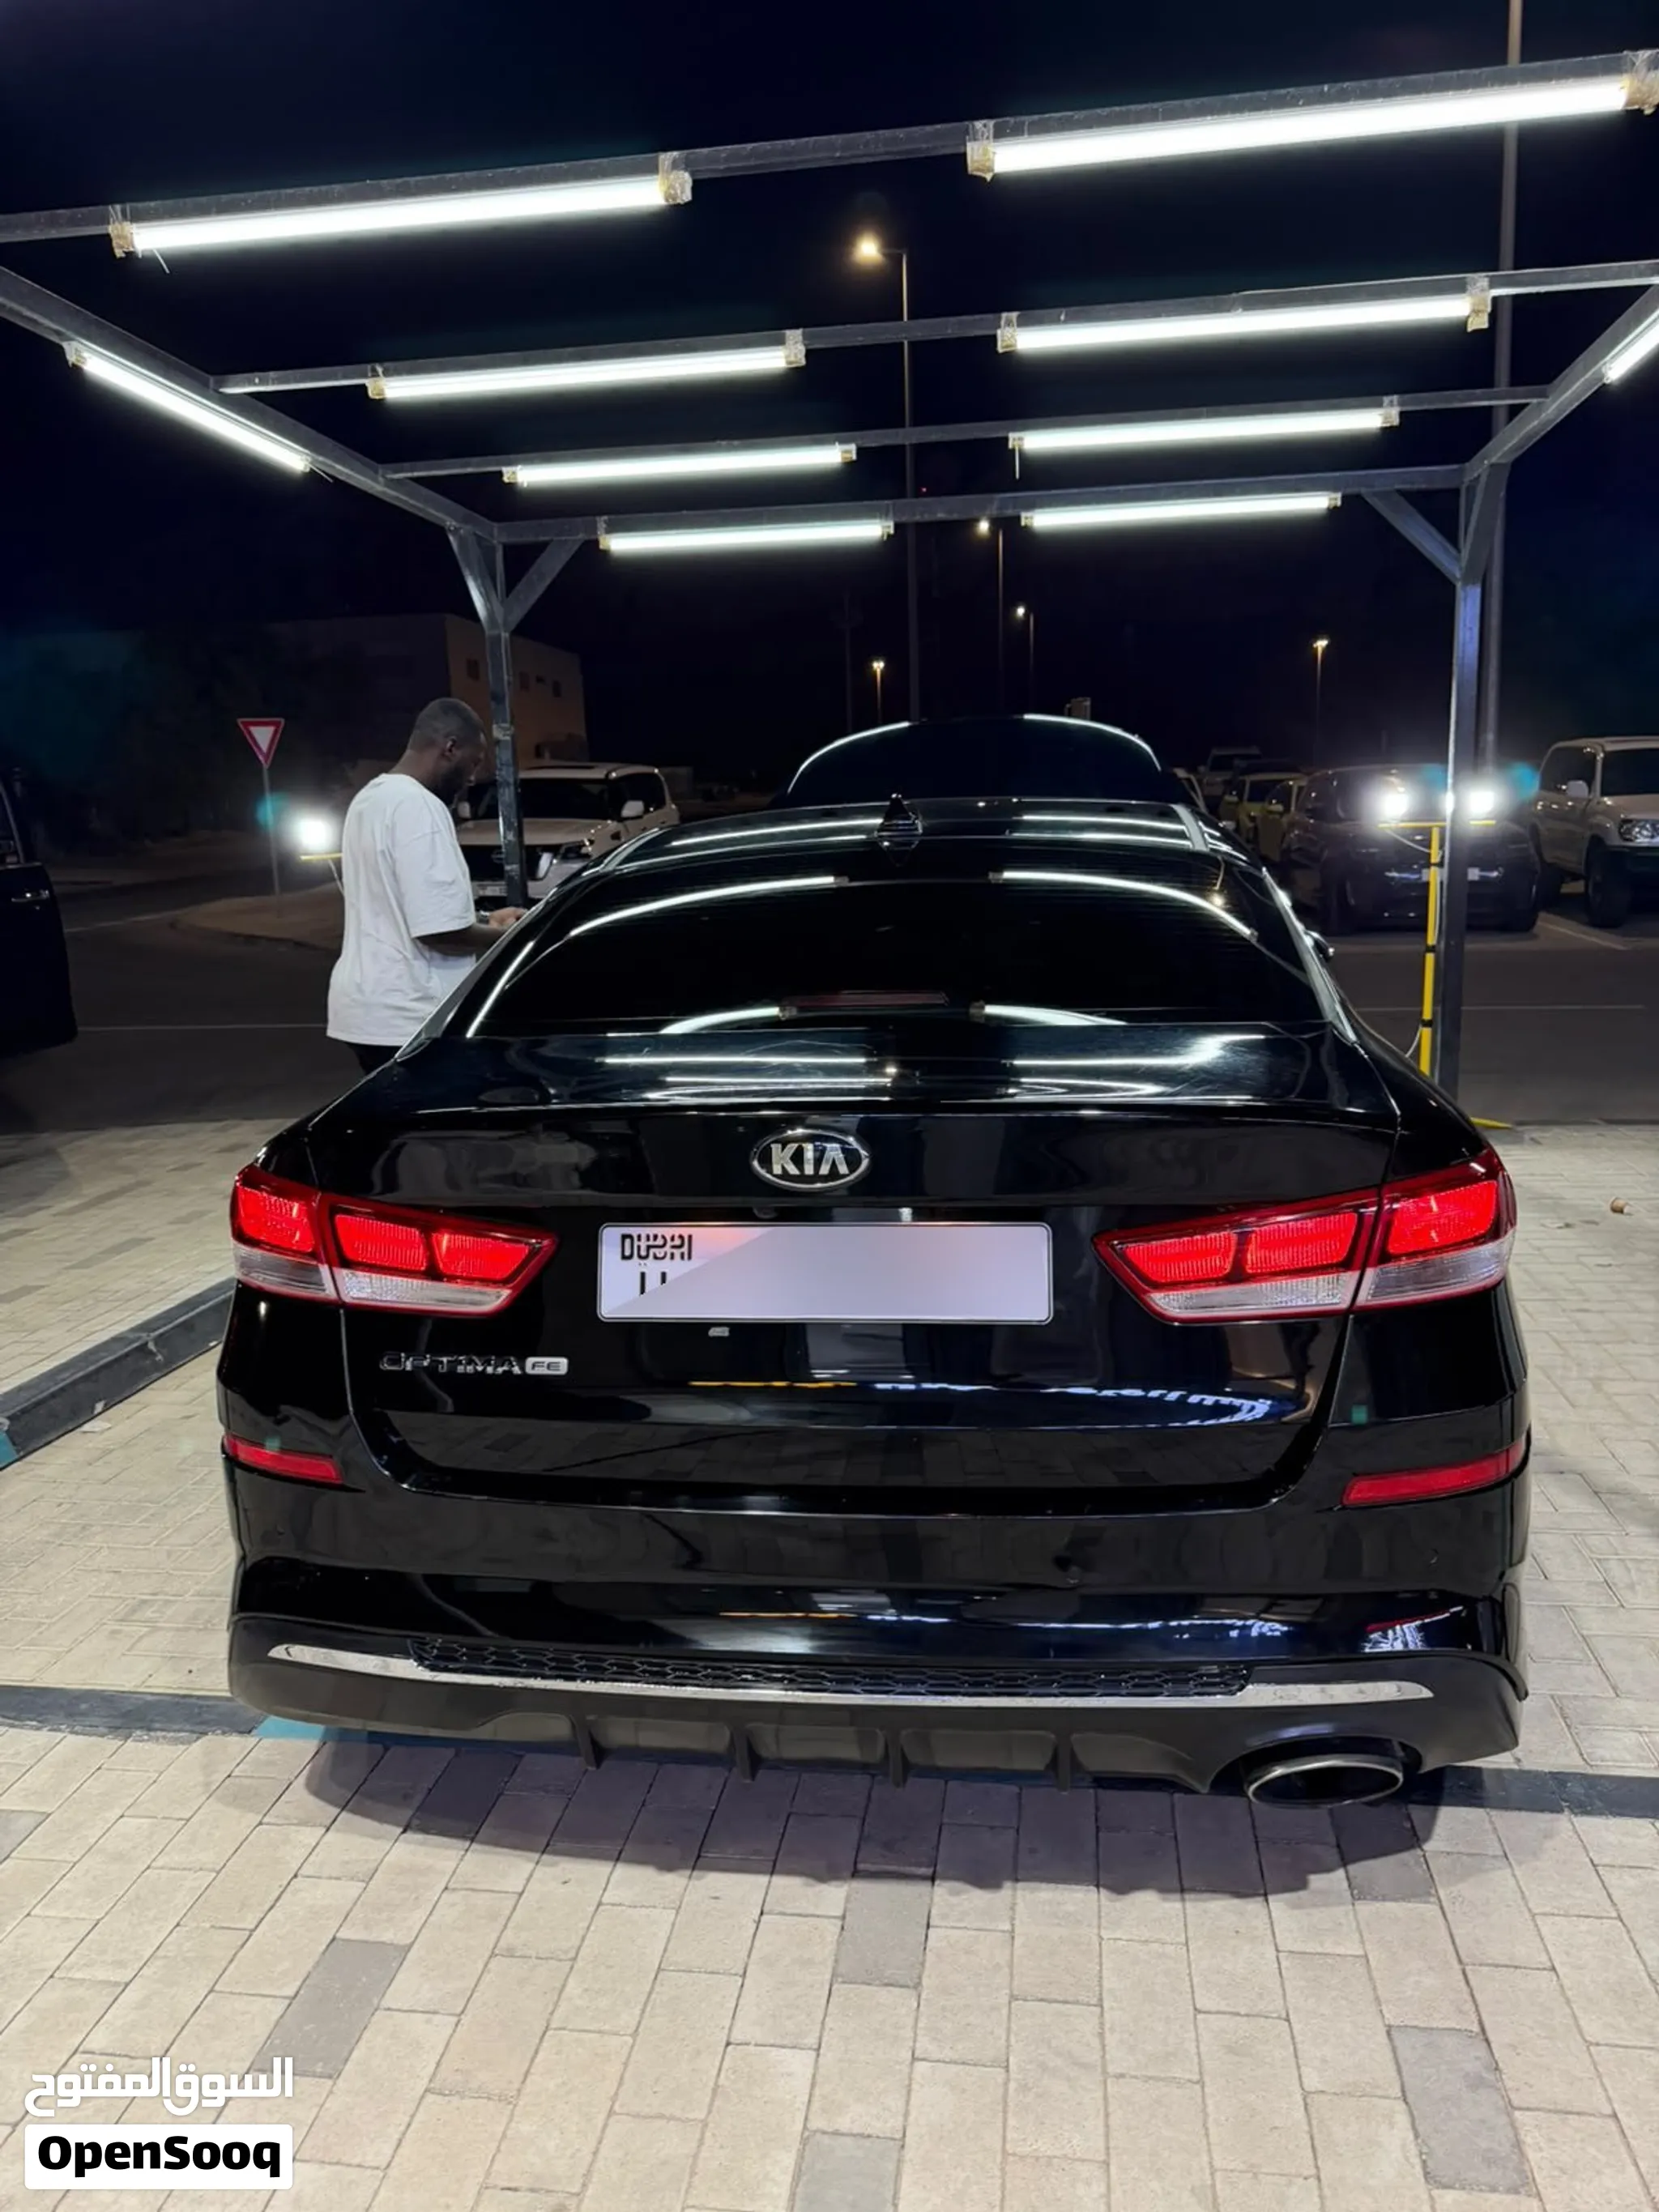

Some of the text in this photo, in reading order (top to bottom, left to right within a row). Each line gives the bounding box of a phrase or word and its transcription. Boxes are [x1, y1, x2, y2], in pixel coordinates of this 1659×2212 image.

[770, 1143, 850, 1174] KIA
[380, 1352, 565, 1375] OPTIMA FE
